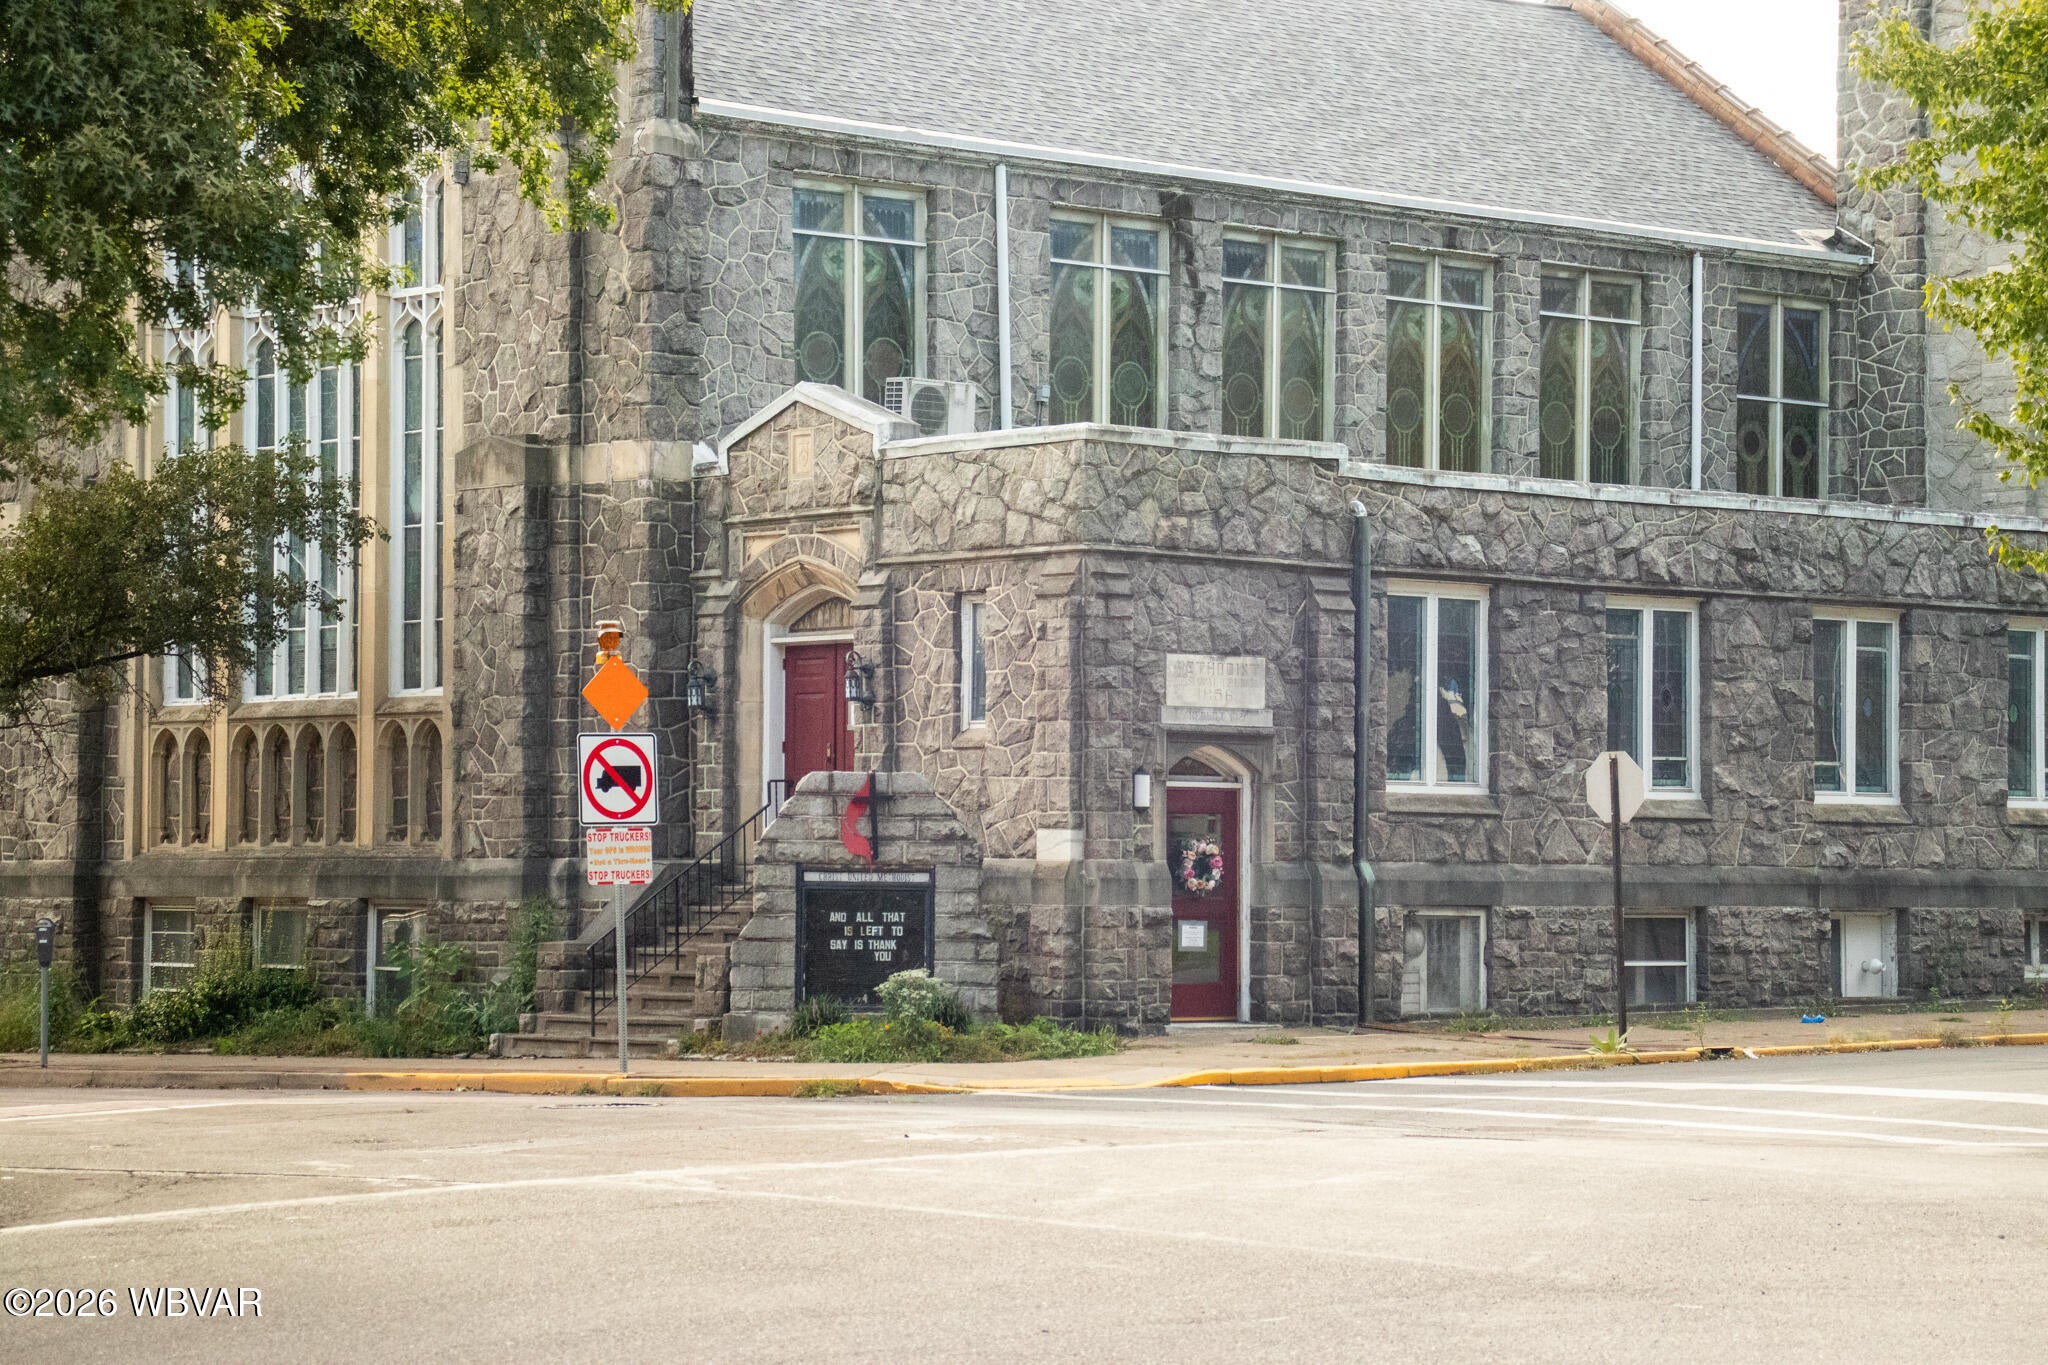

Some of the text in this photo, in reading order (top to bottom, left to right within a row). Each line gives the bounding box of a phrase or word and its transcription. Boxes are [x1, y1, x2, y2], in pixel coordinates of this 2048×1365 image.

[587, 832, 652, 842] STOP TRUCKERS!
[588, 870, 653, 881] STOP TRUCKERS!
[829, 912, 906, 923] AND ALL THAT
[844, 926, 904, 937] IS LEFT TO
[830, 939, 897, 950] SAY IS THANK
[874, 951, 892, 962] YOU
